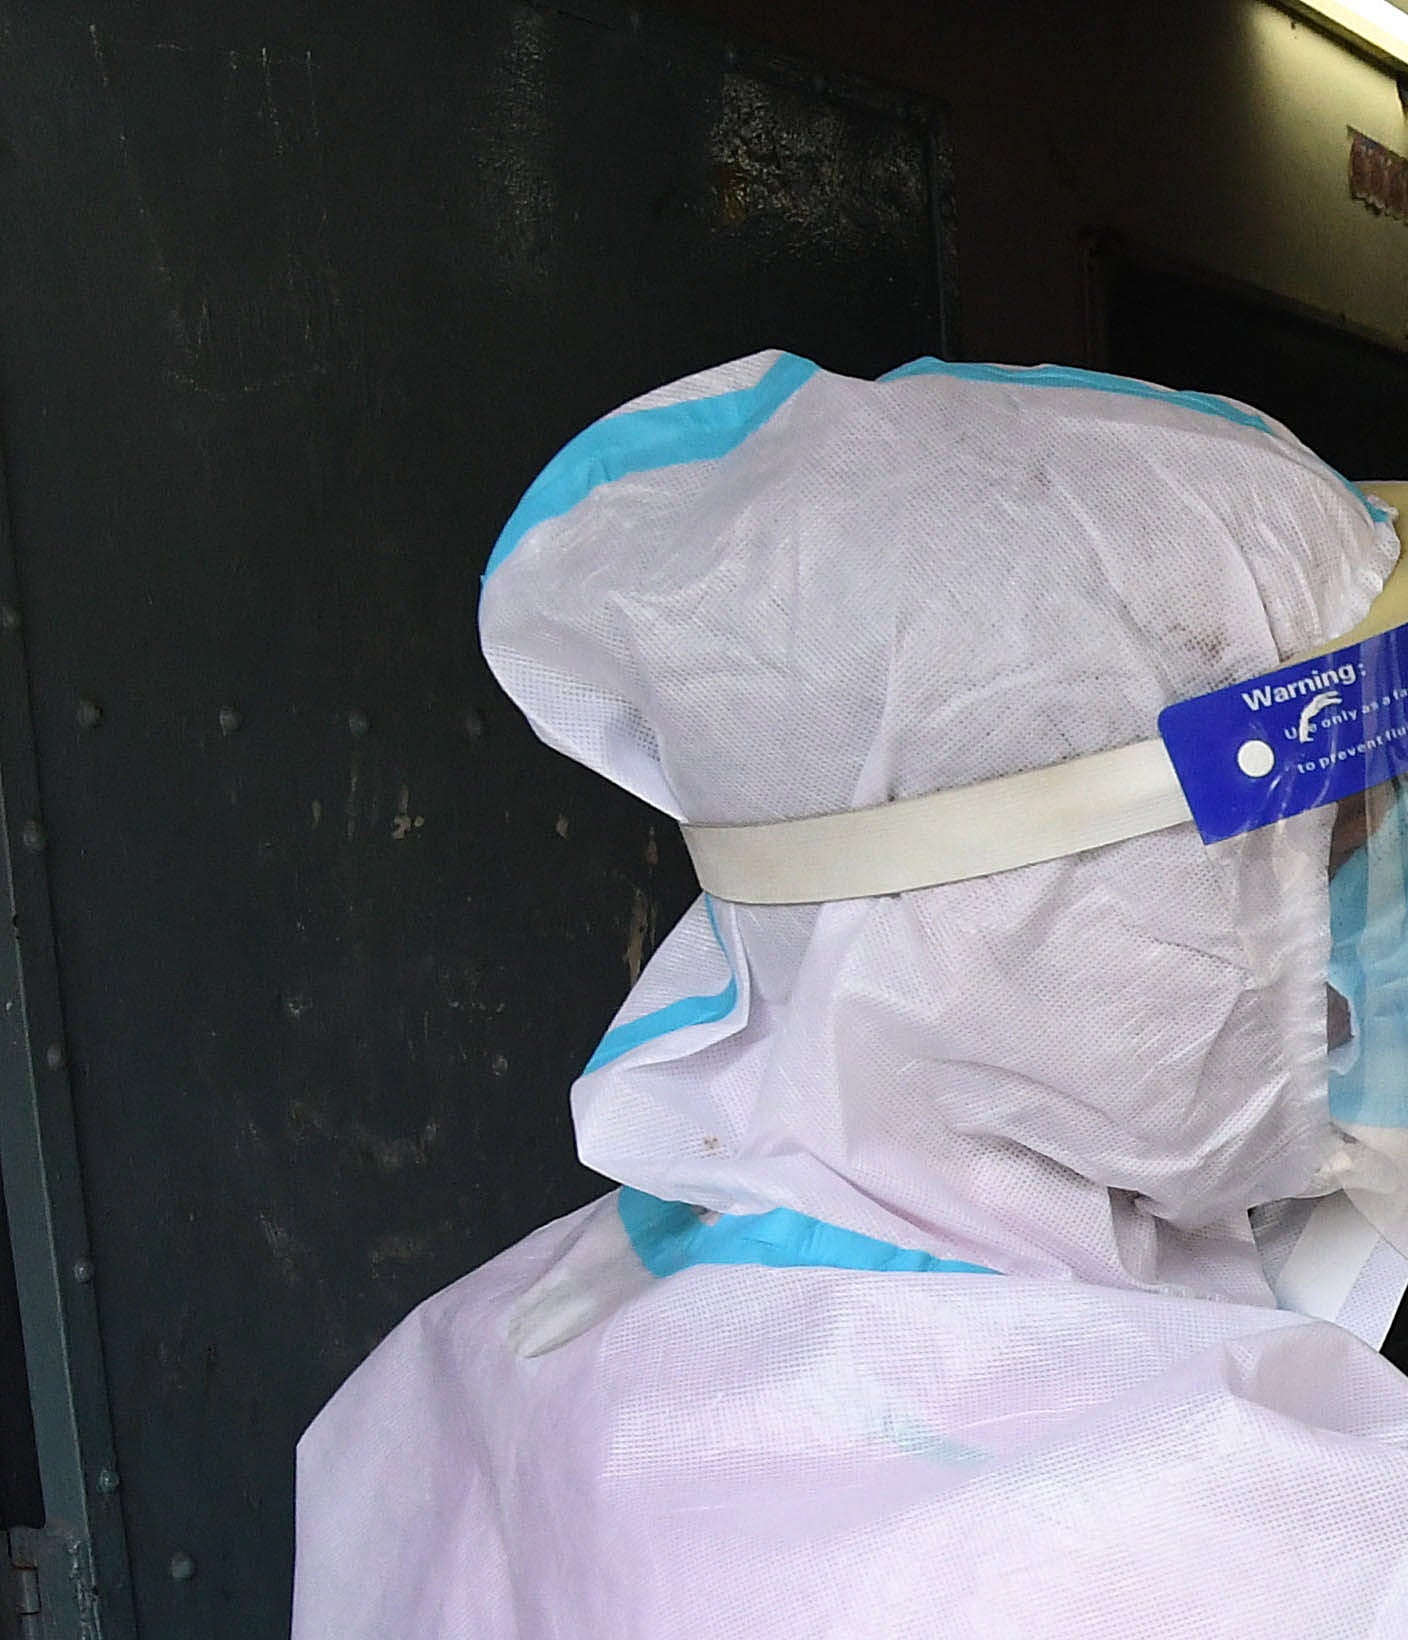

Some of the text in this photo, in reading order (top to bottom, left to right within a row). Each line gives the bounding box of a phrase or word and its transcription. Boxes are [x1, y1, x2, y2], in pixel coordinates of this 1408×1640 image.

[1321, 708, 1358, 729] only
[1361, 702, 1380, 715] as
[1382, 696, 1391, 706] a
[1297, 760, 1316, 774] to
[1319, 736, 1384, 768] prevent
